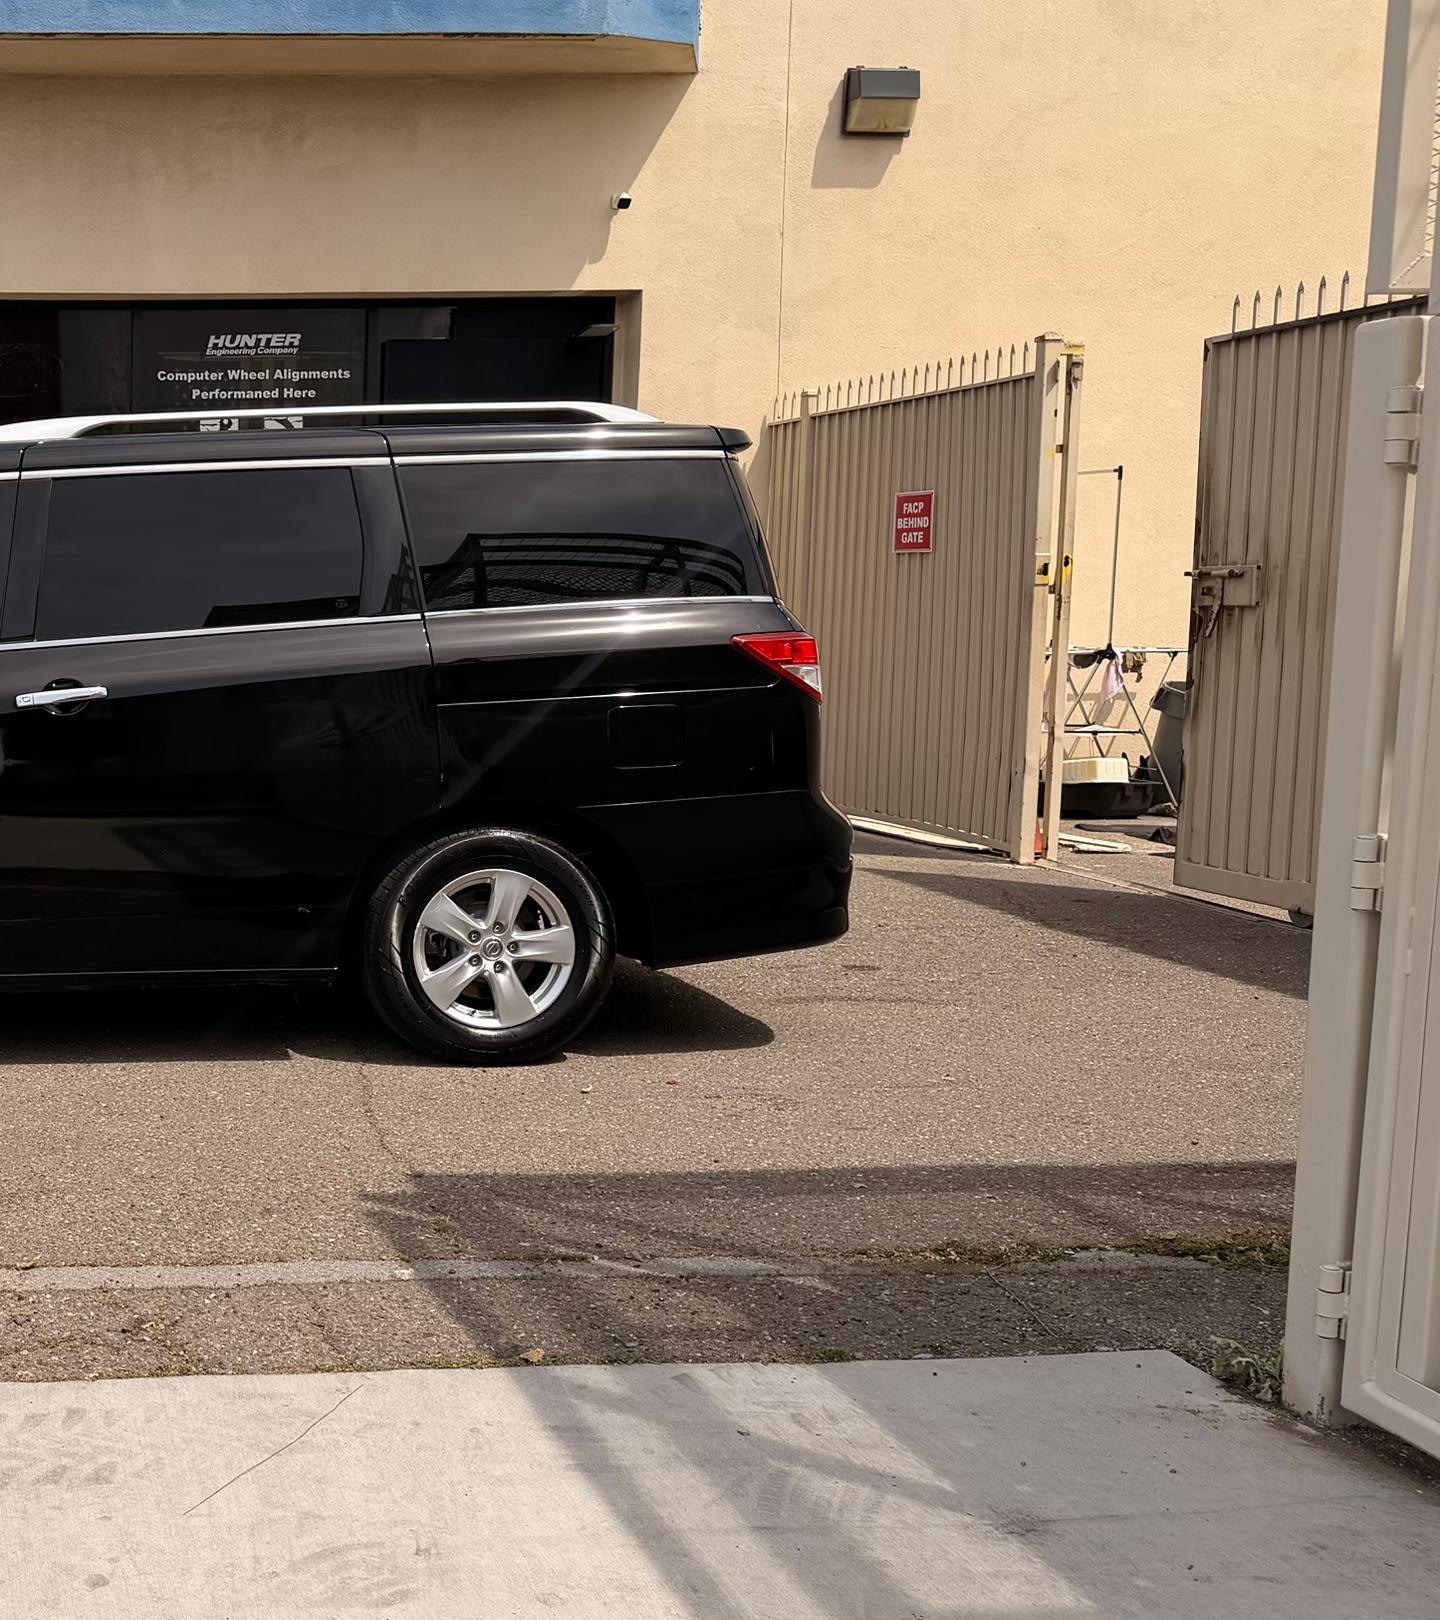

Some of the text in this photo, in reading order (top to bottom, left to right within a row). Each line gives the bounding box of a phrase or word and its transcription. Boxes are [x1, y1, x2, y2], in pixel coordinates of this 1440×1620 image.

[207, 333, 302, 348] HUNTER
[206, 346, 299, 356] Engineering Company
[157, 368, 351, 383] Computer Wheel Alignments
[192, 387, 316, 399] Performaned Here
[903, 501, 924, 514] FACP
[897, 516, 929, 529] BEHIND
[901, 531, 924, 543] GATE
